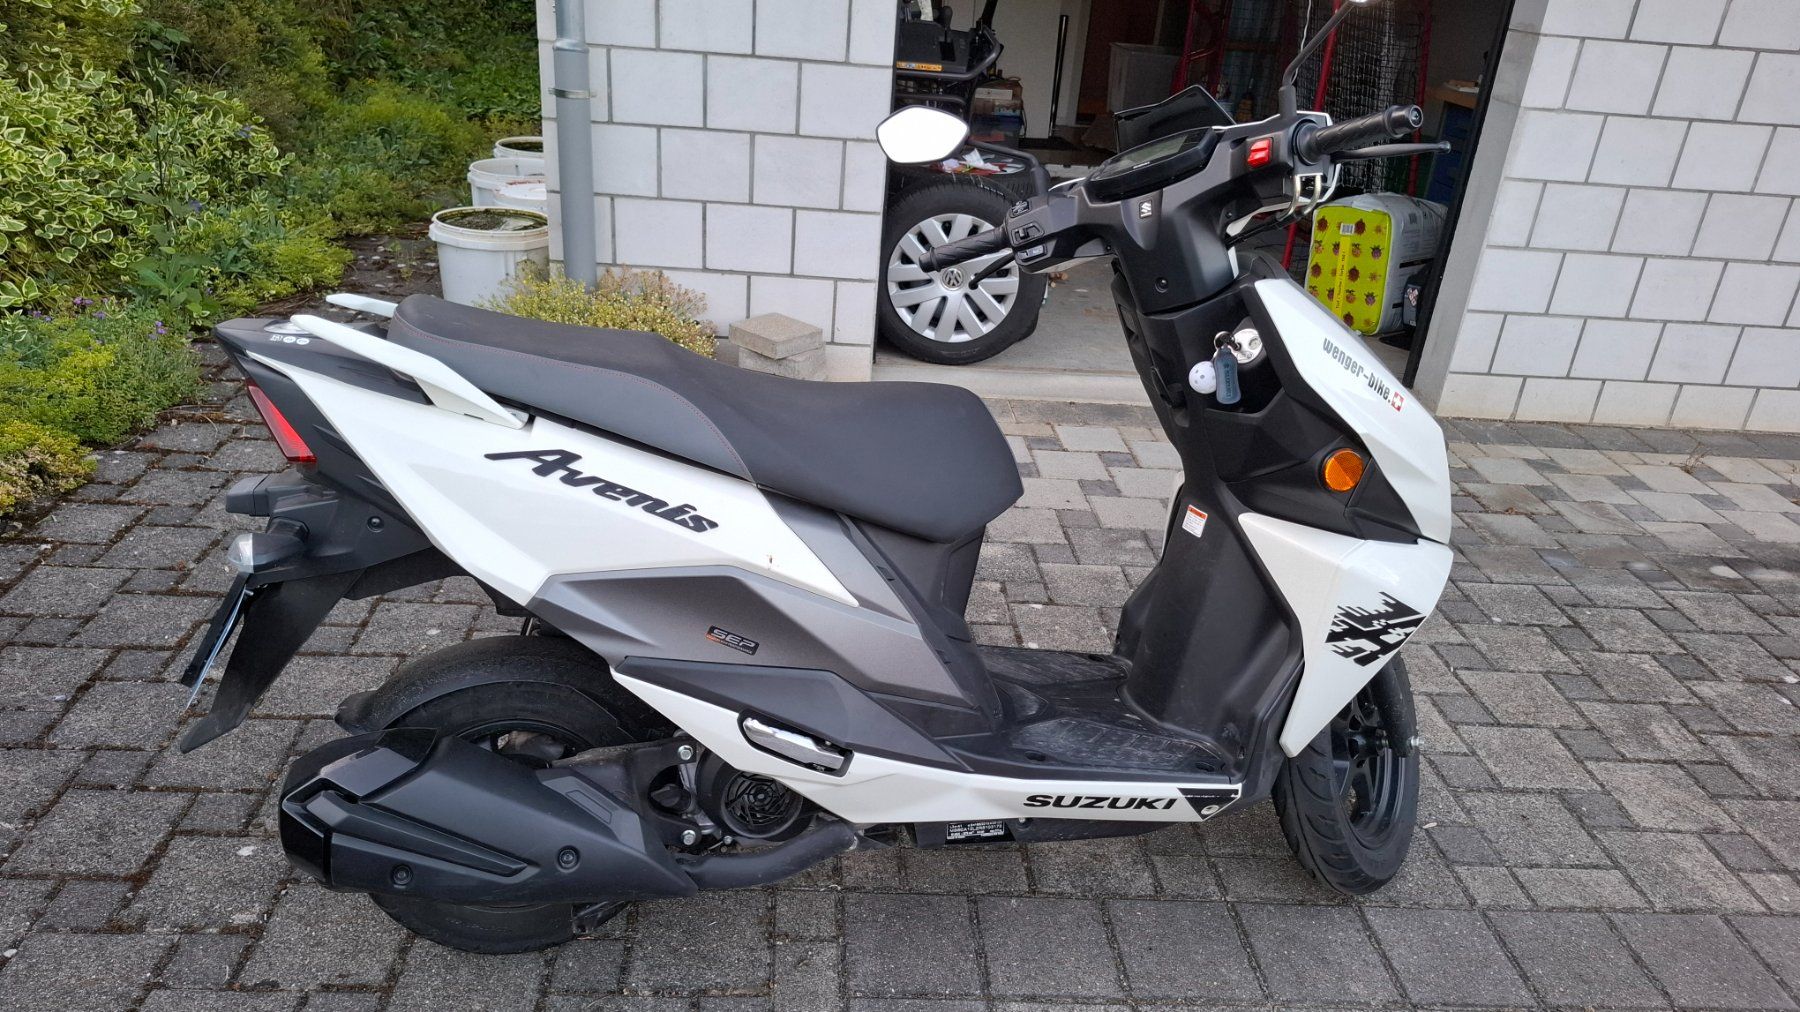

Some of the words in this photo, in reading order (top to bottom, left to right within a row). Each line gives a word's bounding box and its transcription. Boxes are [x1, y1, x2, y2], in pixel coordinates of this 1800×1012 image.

[483, 449, 719, 533] Avenis
[710, 628, 756, 648] SEP
[1023, 794, 1178, 810] SUZUKI
